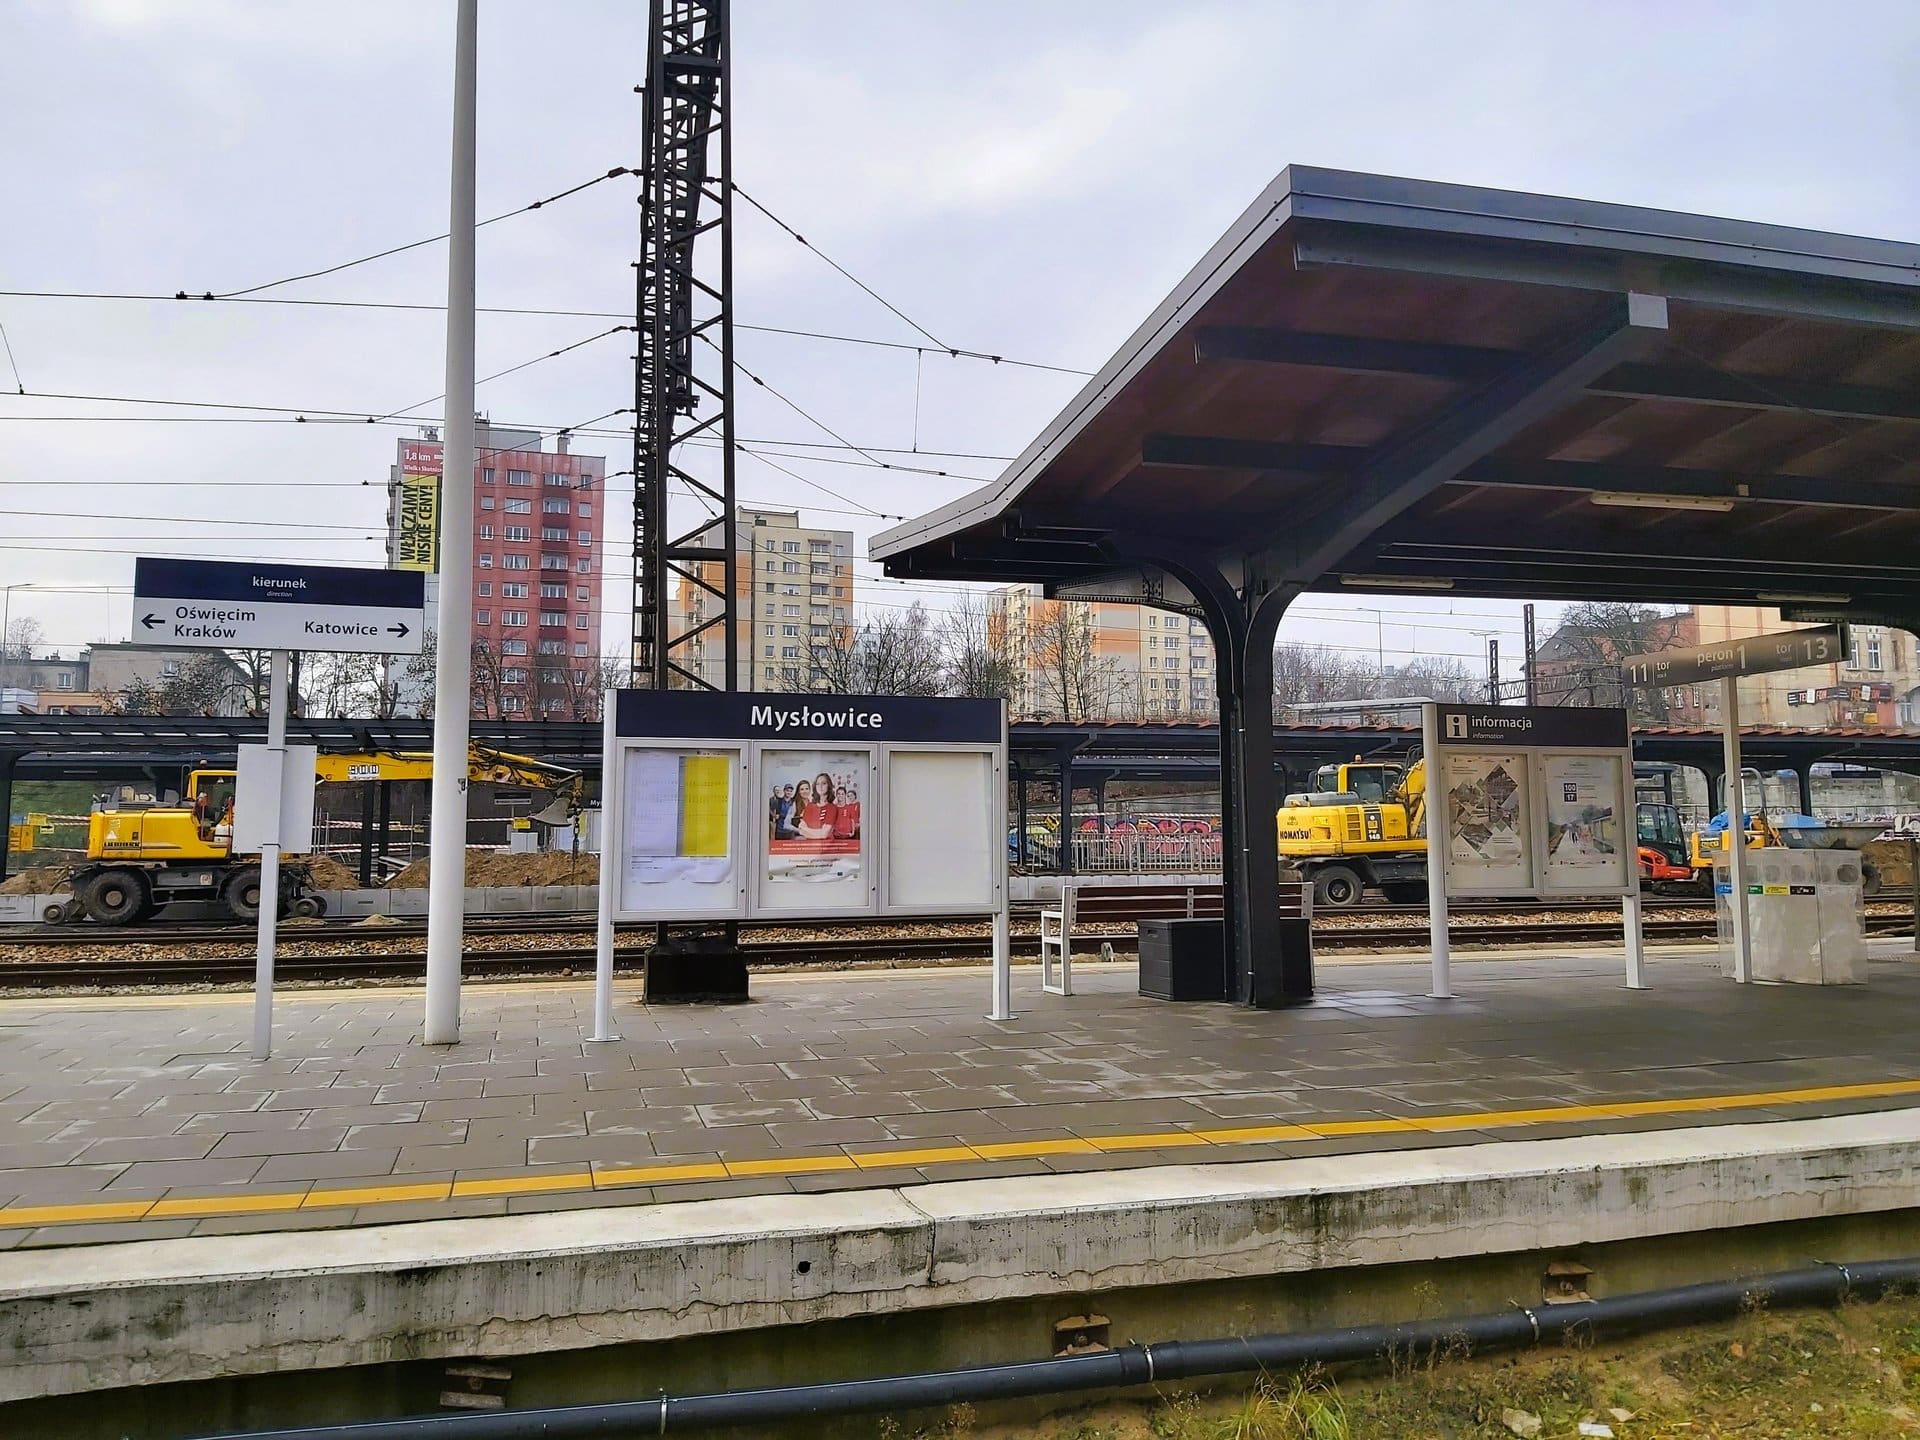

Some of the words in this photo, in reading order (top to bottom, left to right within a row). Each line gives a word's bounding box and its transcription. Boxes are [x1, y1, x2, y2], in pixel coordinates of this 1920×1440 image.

[404, 449, 418, 461] 1,8
[419, 452, 431, 462] km
[418, 485, 433, 519] CENY!
[400, 485, 418, 561] WŁĄCZAMY
[416, 524, 432, 563] NISKIE
[252, 575, 307, 590] kierunek
[266, 590, 293, 598] direction
[175, 606, 256, 623] Oświęcim
[174, 624, 237, 639] Kraków
[304, 620, 379, 636] Katowice
[1697, 648, 1734, 667] peron
[1737, 644, 1746, 670] 1
[1775, 643, 1793, 655] tor
[1803, 637, 1828, 661] 13
[1629, 662, 1648, 684] 11
[1655, 661, 1671, 672] tor
[750, 705, 883, 732] Mysłowice
[1471, 715, 1533, 731] informacja
[1472, 732, 1504, 740] information
[1280, 828, 1310, 840] KOMATSU
